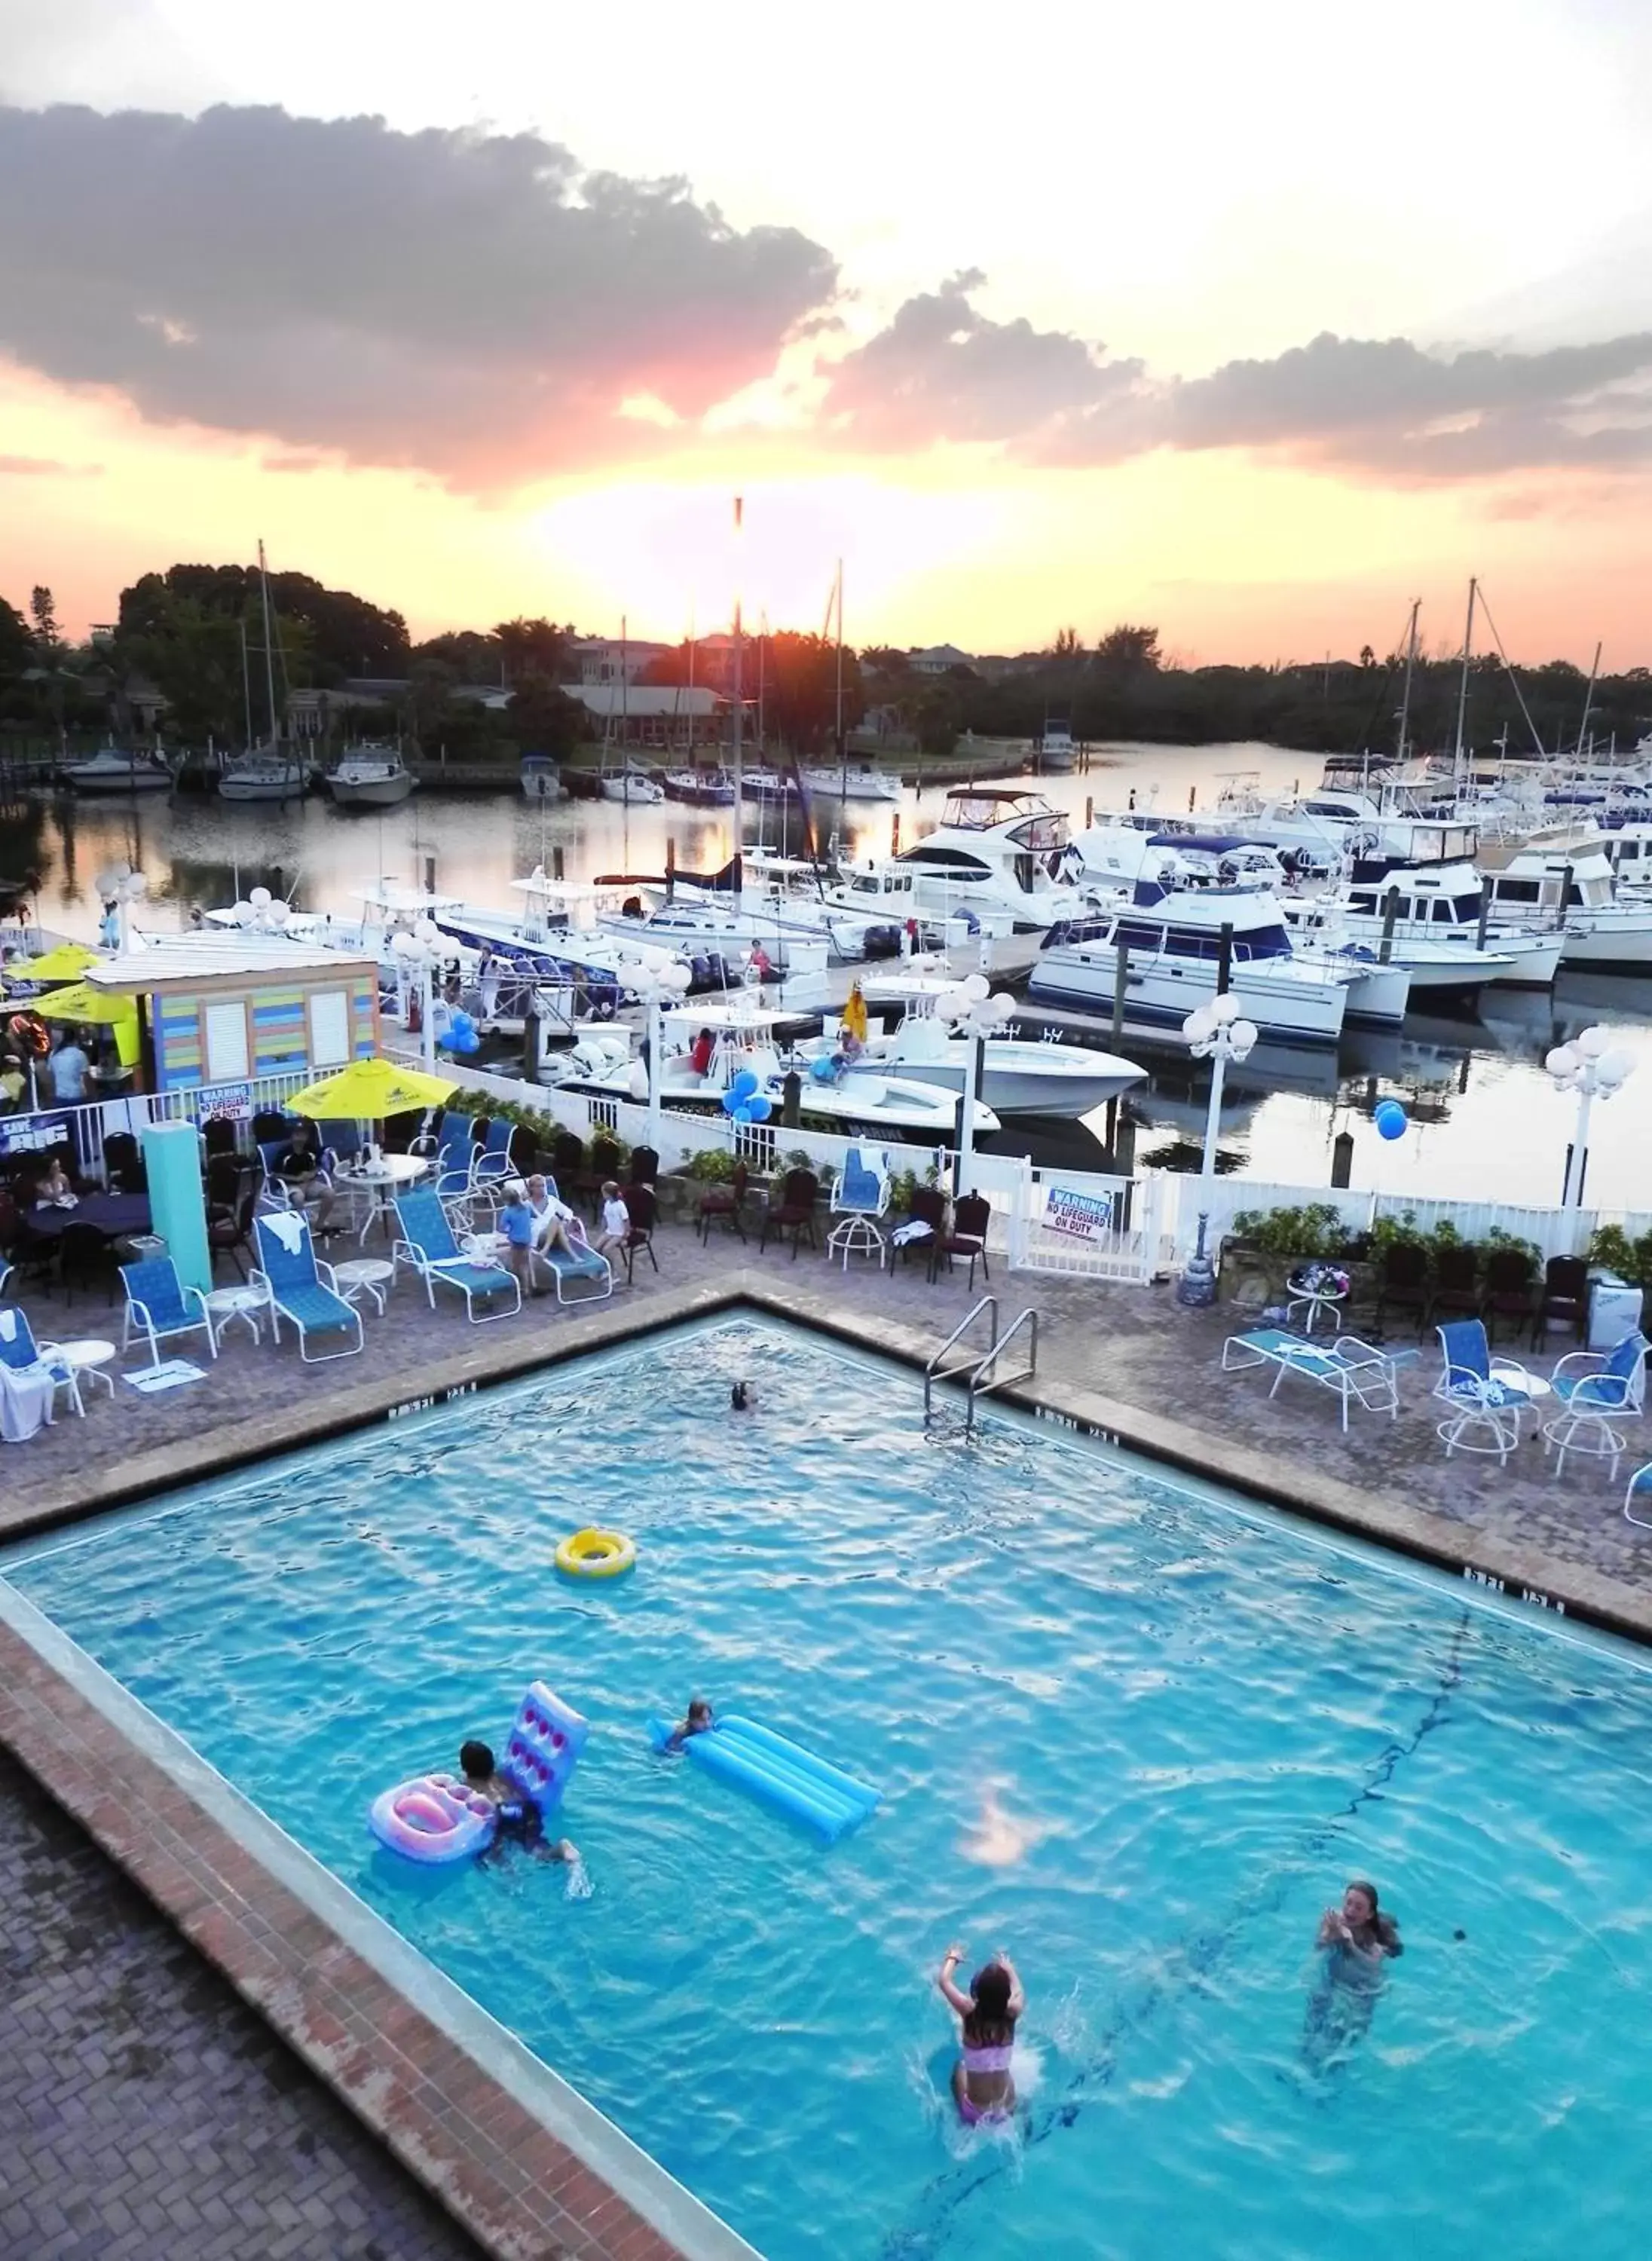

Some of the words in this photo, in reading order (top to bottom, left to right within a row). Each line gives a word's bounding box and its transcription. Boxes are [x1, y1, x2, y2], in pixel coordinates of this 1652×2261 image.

[1055, 1189, 1106, 1216] WARNING
[1047, 1203, 1059, 1215] NO
[1061, 1206, 1106, 1228] LIFEGUARD
[1055, 1216, 1068, 1228] ON
[1069, 1219, 1092, 1235] DUTY
